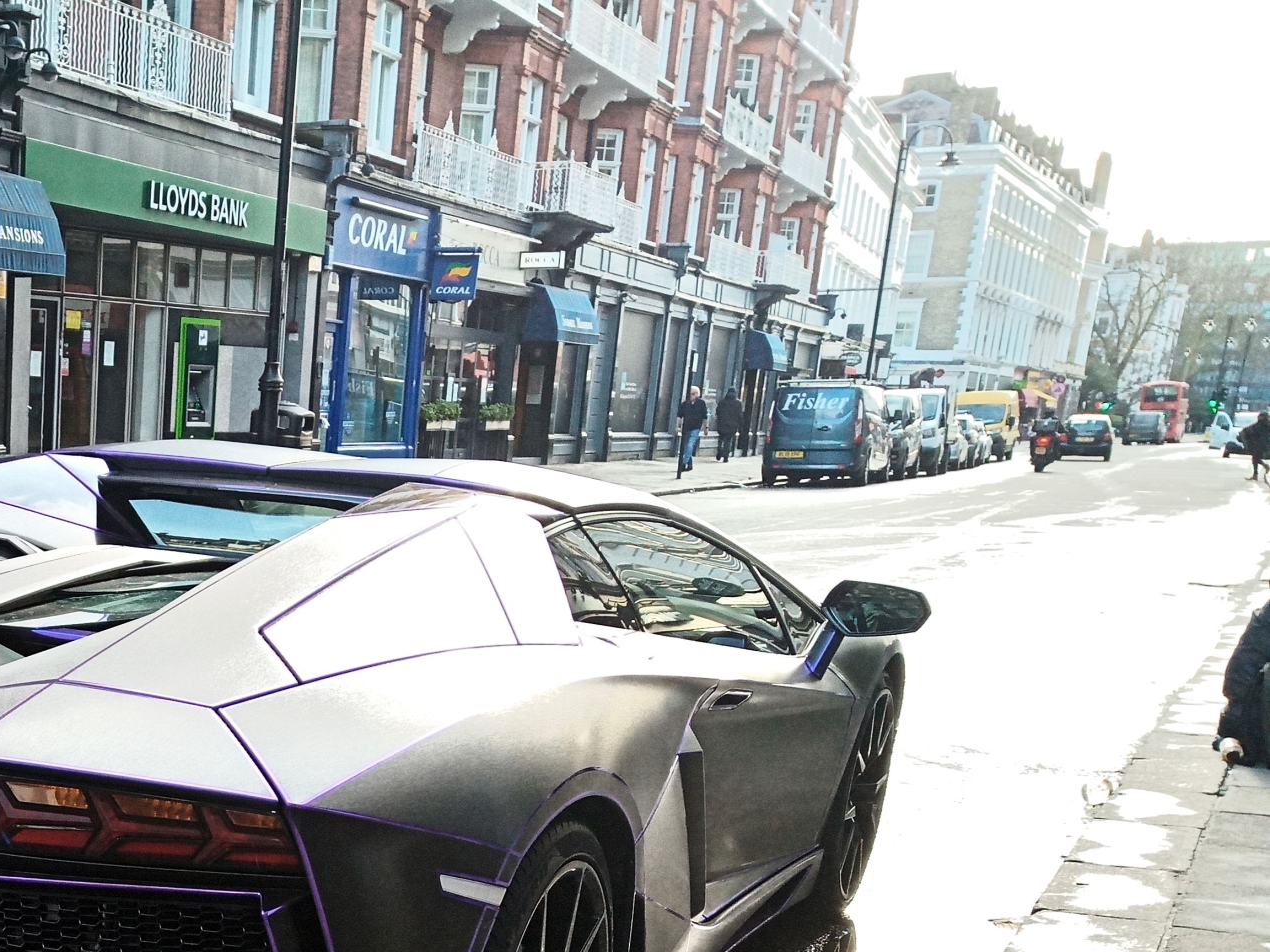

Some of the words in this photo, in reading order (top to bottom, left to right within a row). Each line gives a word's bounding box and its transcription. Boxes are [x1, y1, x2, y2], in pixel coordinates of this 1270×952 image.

[149, 180, 207, 219] LLOYDS
[211, 194, 249, 228] BANK
[348, 213, 407, 255] CORAL
[524, 256, 556, 264] ROCCA
[436, 286, 471, 295] CORAL
[781, 392, 850, 411] Fisher
